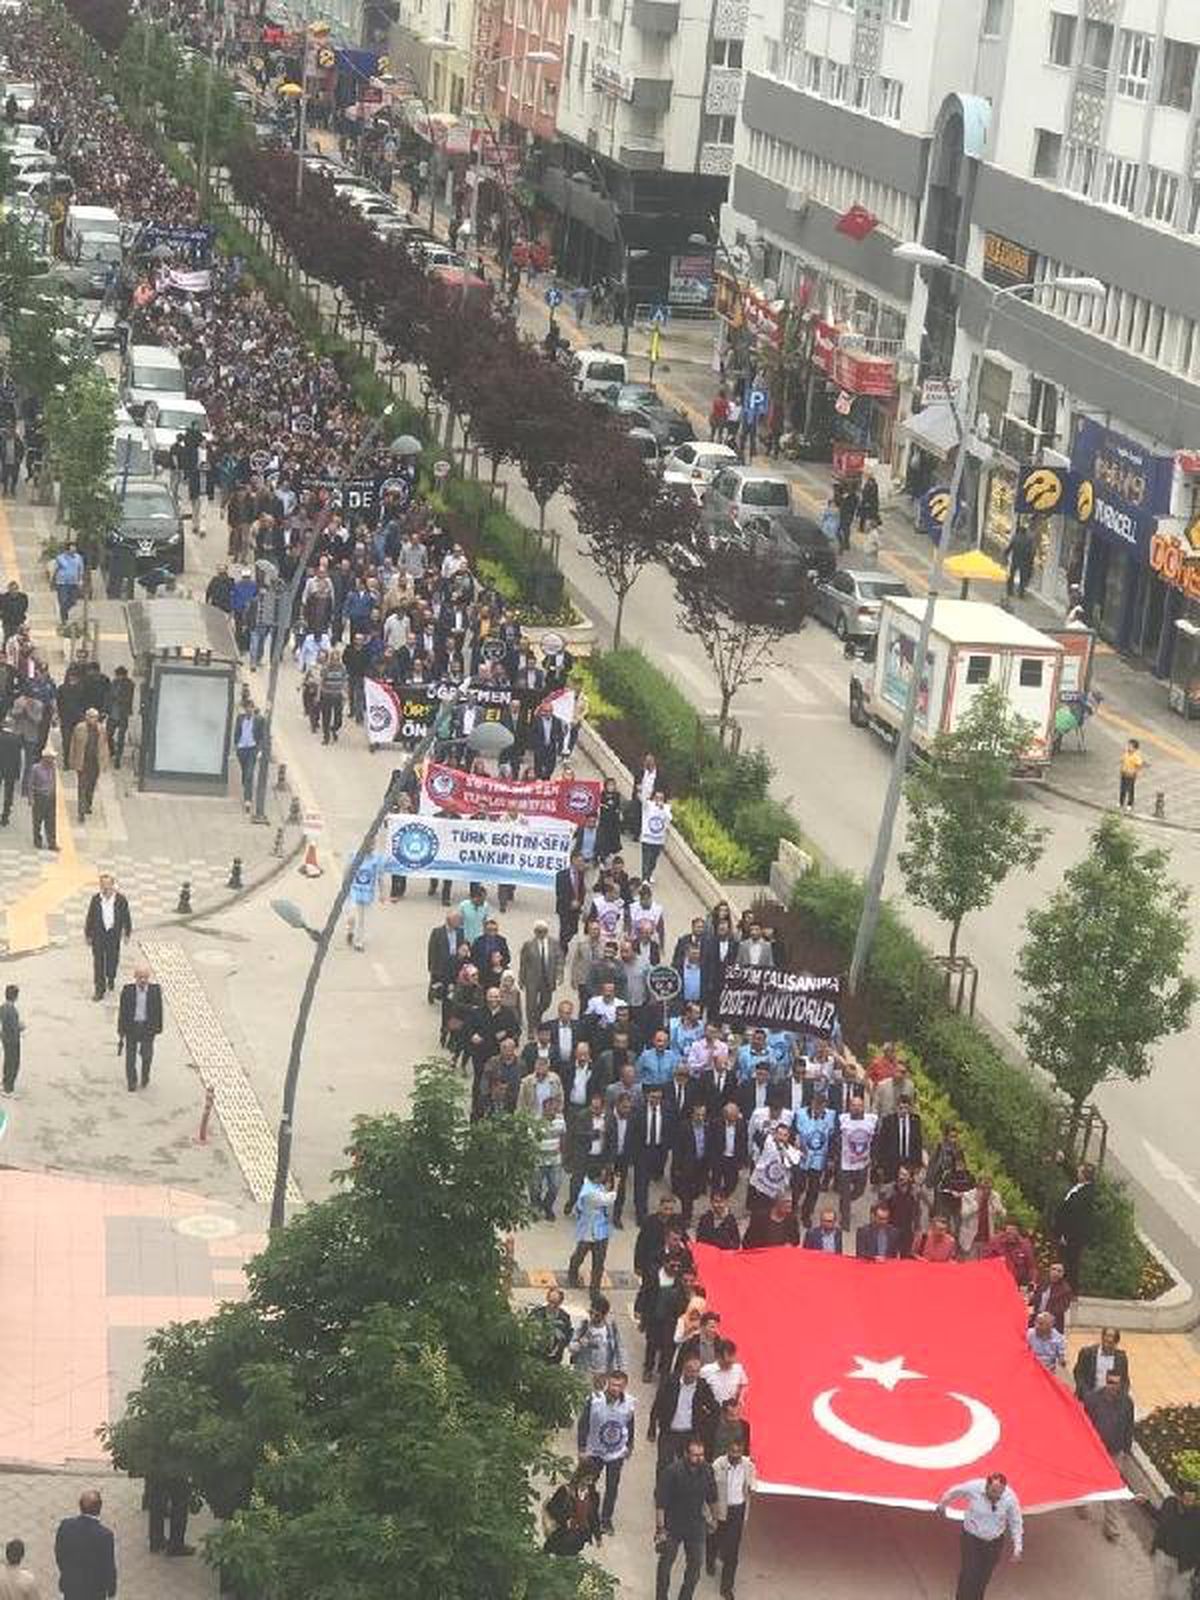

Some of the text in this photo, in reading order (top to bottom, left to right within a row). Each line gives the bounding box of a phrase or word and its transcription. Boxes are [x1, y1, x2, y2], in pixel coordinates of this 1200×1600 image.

[750, 391, 765, 408] P
[452, 828, 488, 845] TÜRK
[459, 849, 568, 871] ÇANKIRI ŞUBESİ
